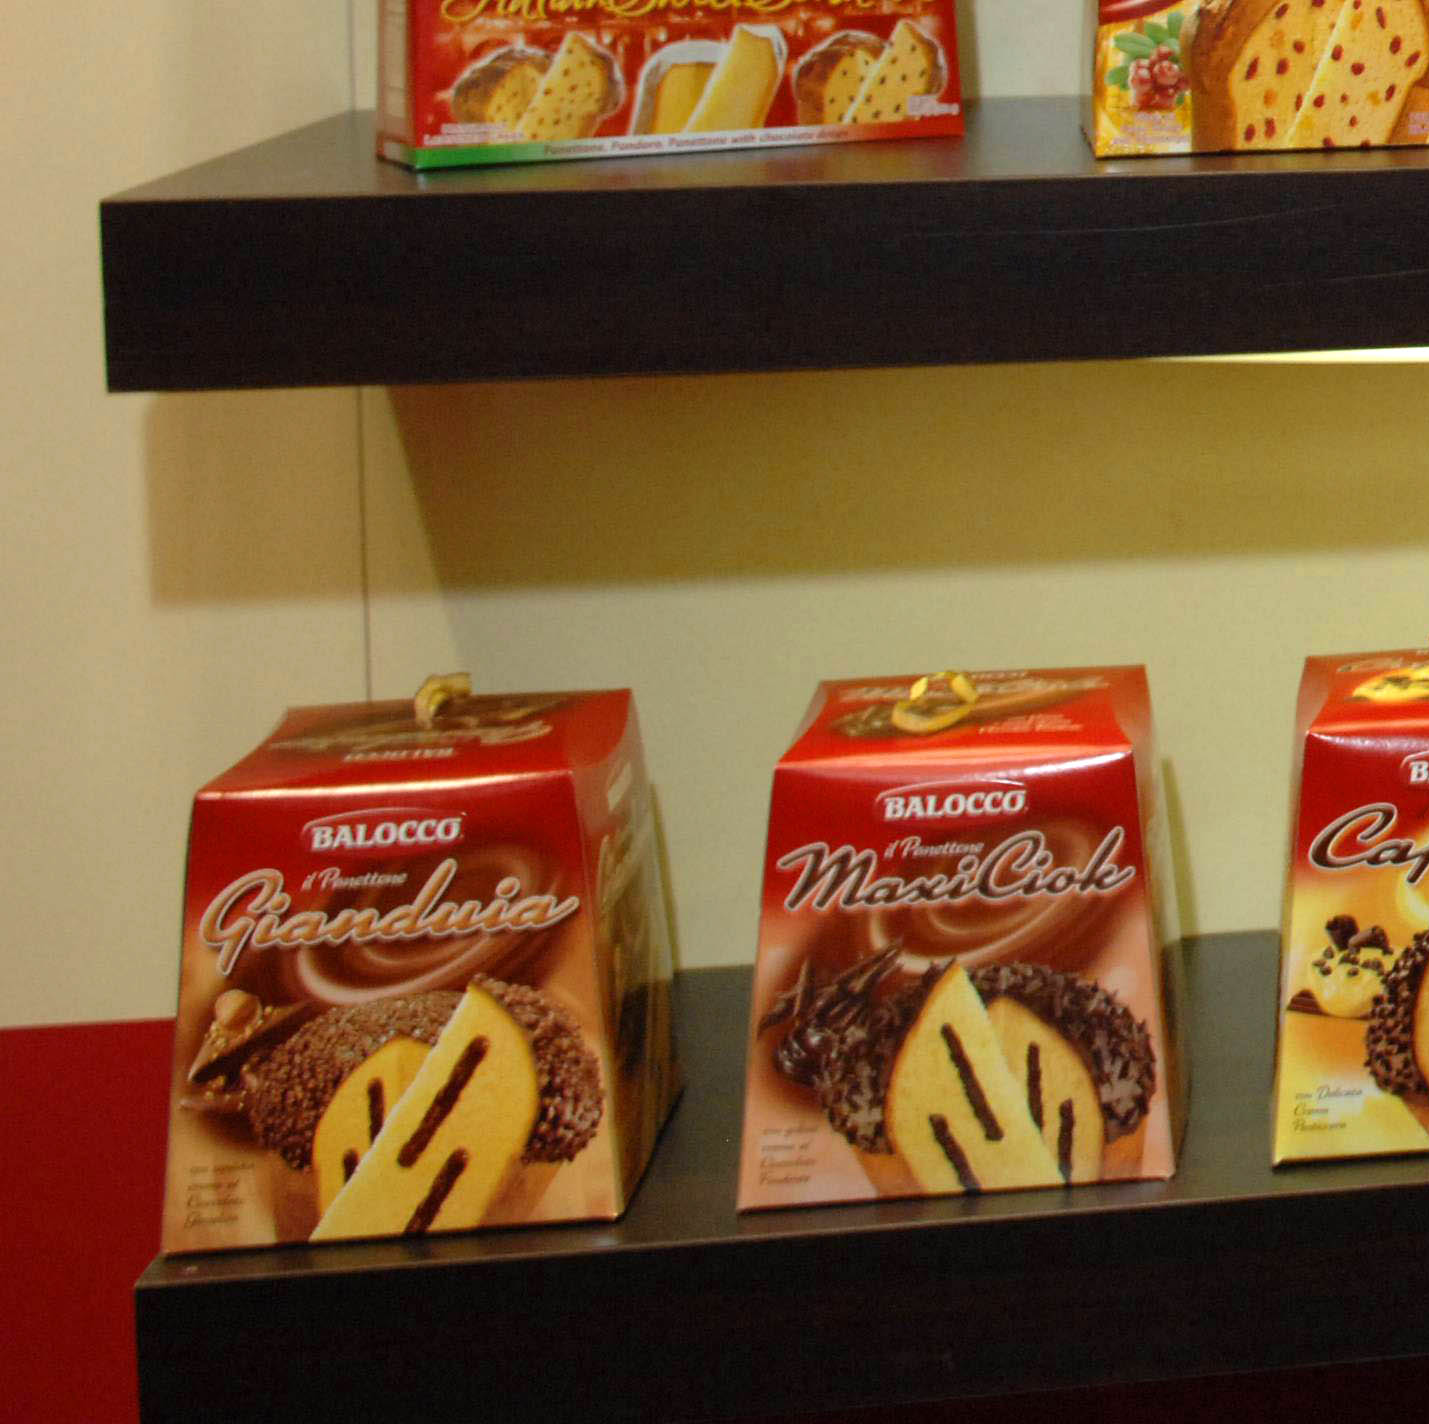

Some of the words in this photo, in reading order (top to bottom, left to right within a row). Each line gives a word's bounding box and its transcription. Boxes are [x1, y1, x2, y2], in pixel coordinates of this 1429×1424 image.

[884, 790, 1027, 822] BALOCCO
[311, 817, 462, 852] BALOCCO
[884, 839, 899, 860] il
[900, 835, 986, 859] Panettone
[318, 867, 409, 891] Panettone
[199, 858, 580, 975] Gianduia
